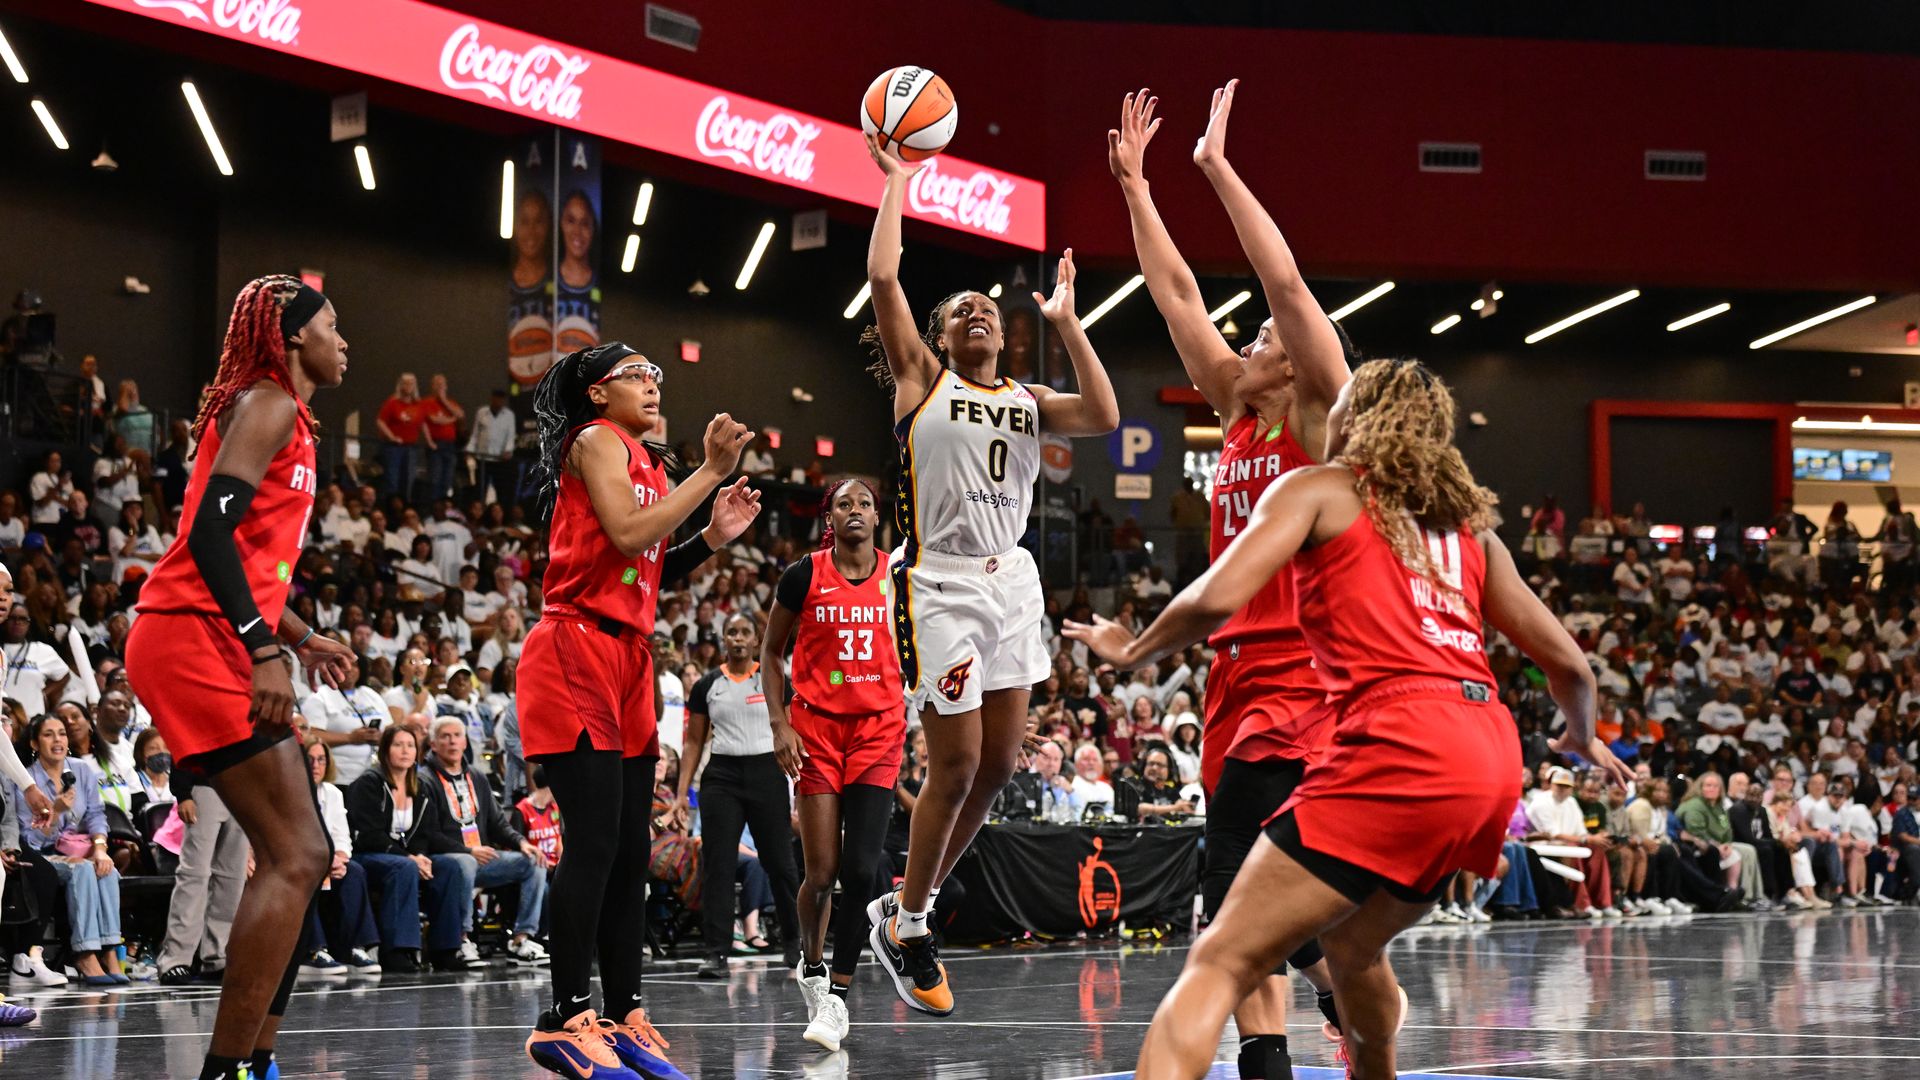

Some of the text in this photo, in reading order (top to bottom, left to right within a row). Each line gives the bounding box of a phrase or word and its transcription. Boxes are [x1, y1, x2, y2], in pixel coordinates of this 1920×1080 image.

[439, 23, 592, 121] Coca-Cola
[892, 68, 923, 97] Wils
[695, 95, 822, 183] Coca-Cola
[908, 157, 1016, 235] Coca-Cola
[950, 399, 1035, 437] FEVER
[988, 438, 1008, 483] 0
[1122, 427, 1153, 467] P
[1214, 454, 1280, 486] TLANTA
[966, 489, 1018, 508] salesforce
[1218, 490, 1252, 537] 24
[816, 606, 887, 623] ATLANT
[838, 629, 873, 661] 33
[845, 674, 864, 683] Cash
[865, 673, 881, 683] App
